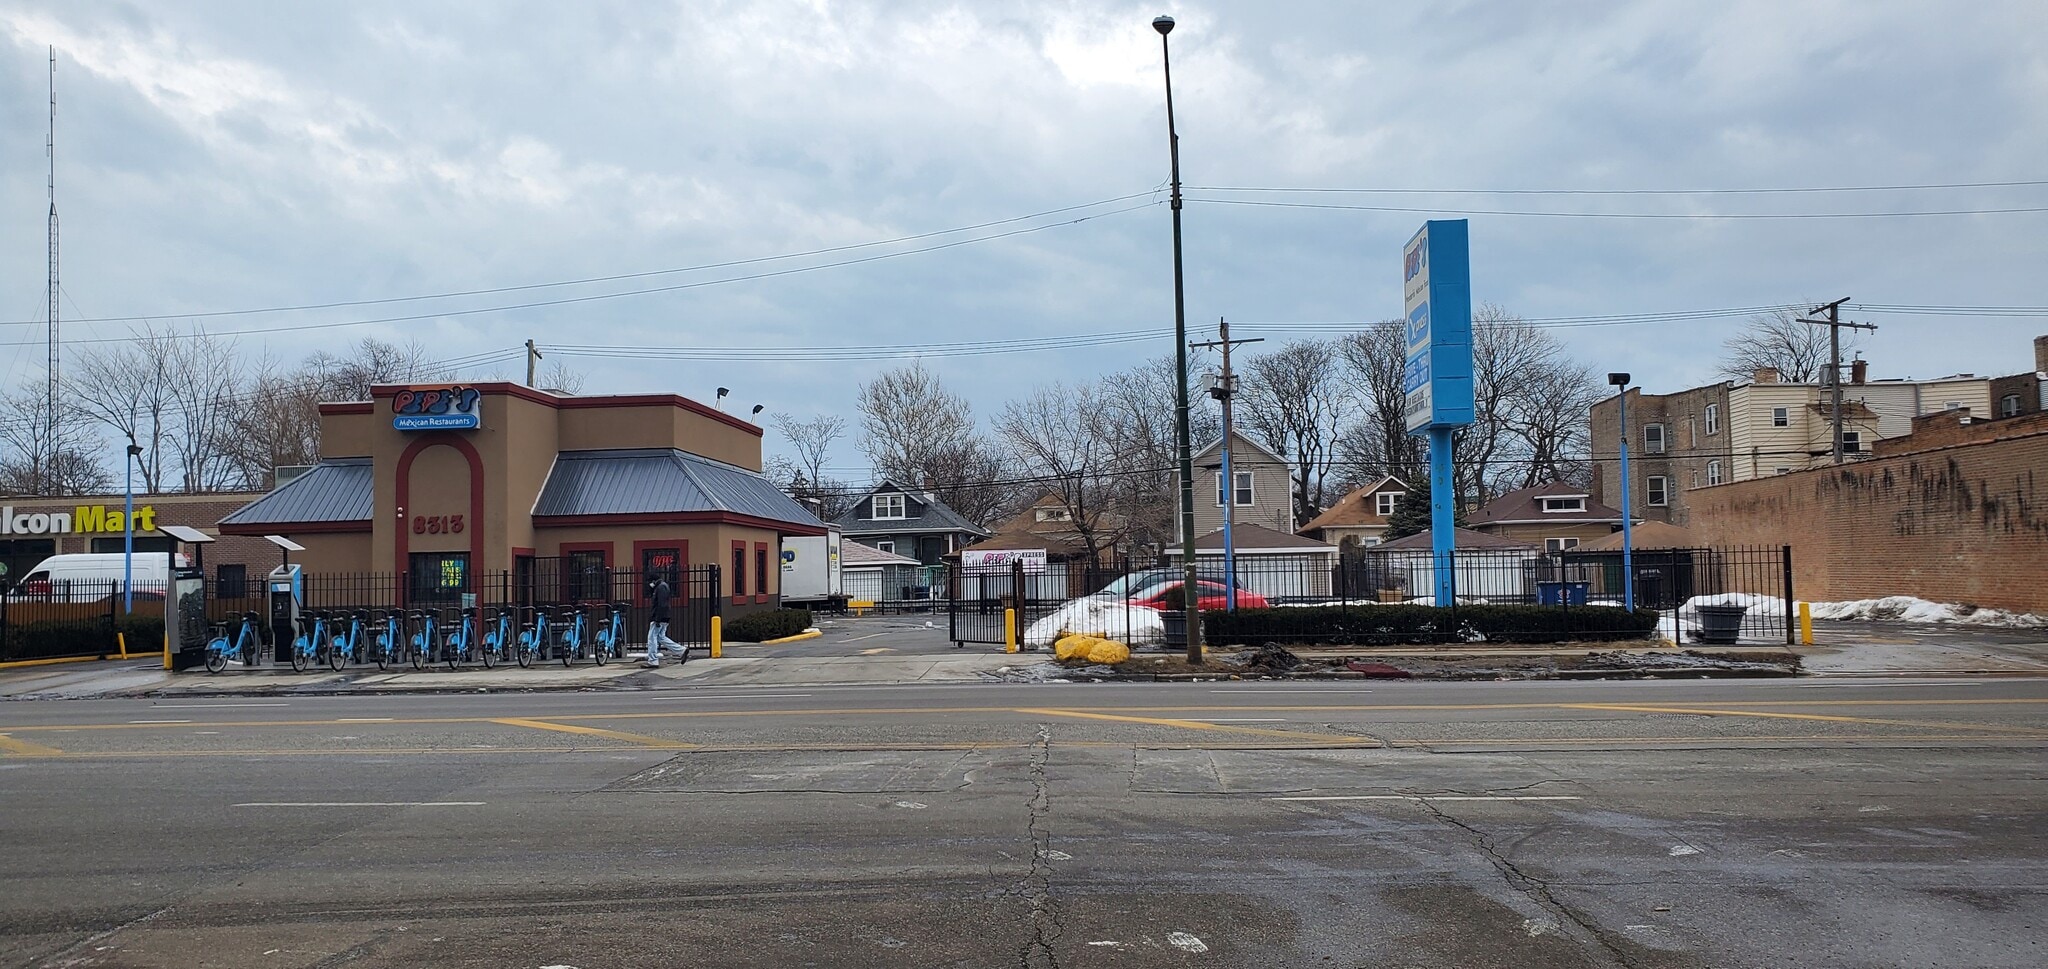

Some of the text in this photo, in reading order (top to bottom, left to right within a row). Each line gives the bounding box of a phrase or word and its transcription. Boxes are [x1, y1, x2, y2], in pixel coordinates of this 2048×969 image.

[392, 386, 478, 413] PEPE'S
[399, 417, 470, 428] Mexican Restaurants
[0, 505, 156, 534] lcon Mart
[413, 514, 464, 534] 8313
